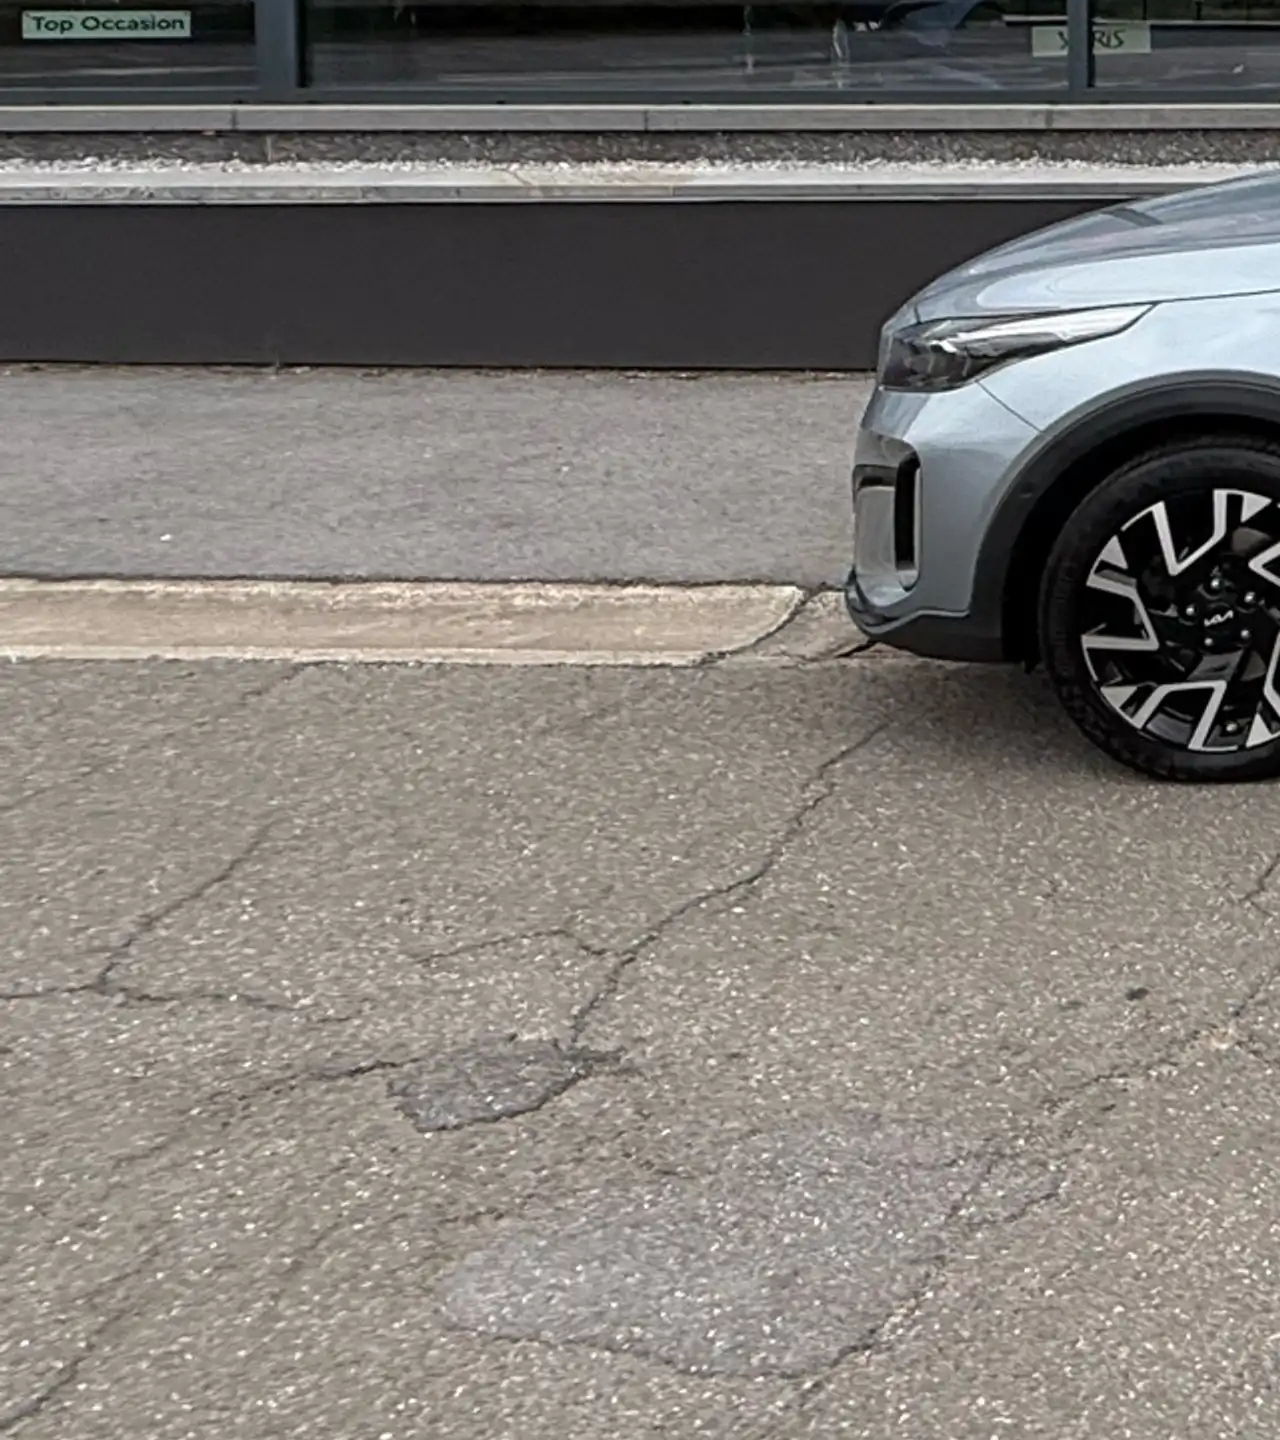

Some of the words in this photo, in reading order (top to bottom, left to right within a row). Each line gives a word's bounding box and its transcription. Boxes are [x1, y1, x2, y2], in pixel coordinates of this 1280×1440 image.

[32, 16, 74, 34] Top
[80, 15, 184, 31] Occasion
[1057, 27, 1127, 49] YRIS
